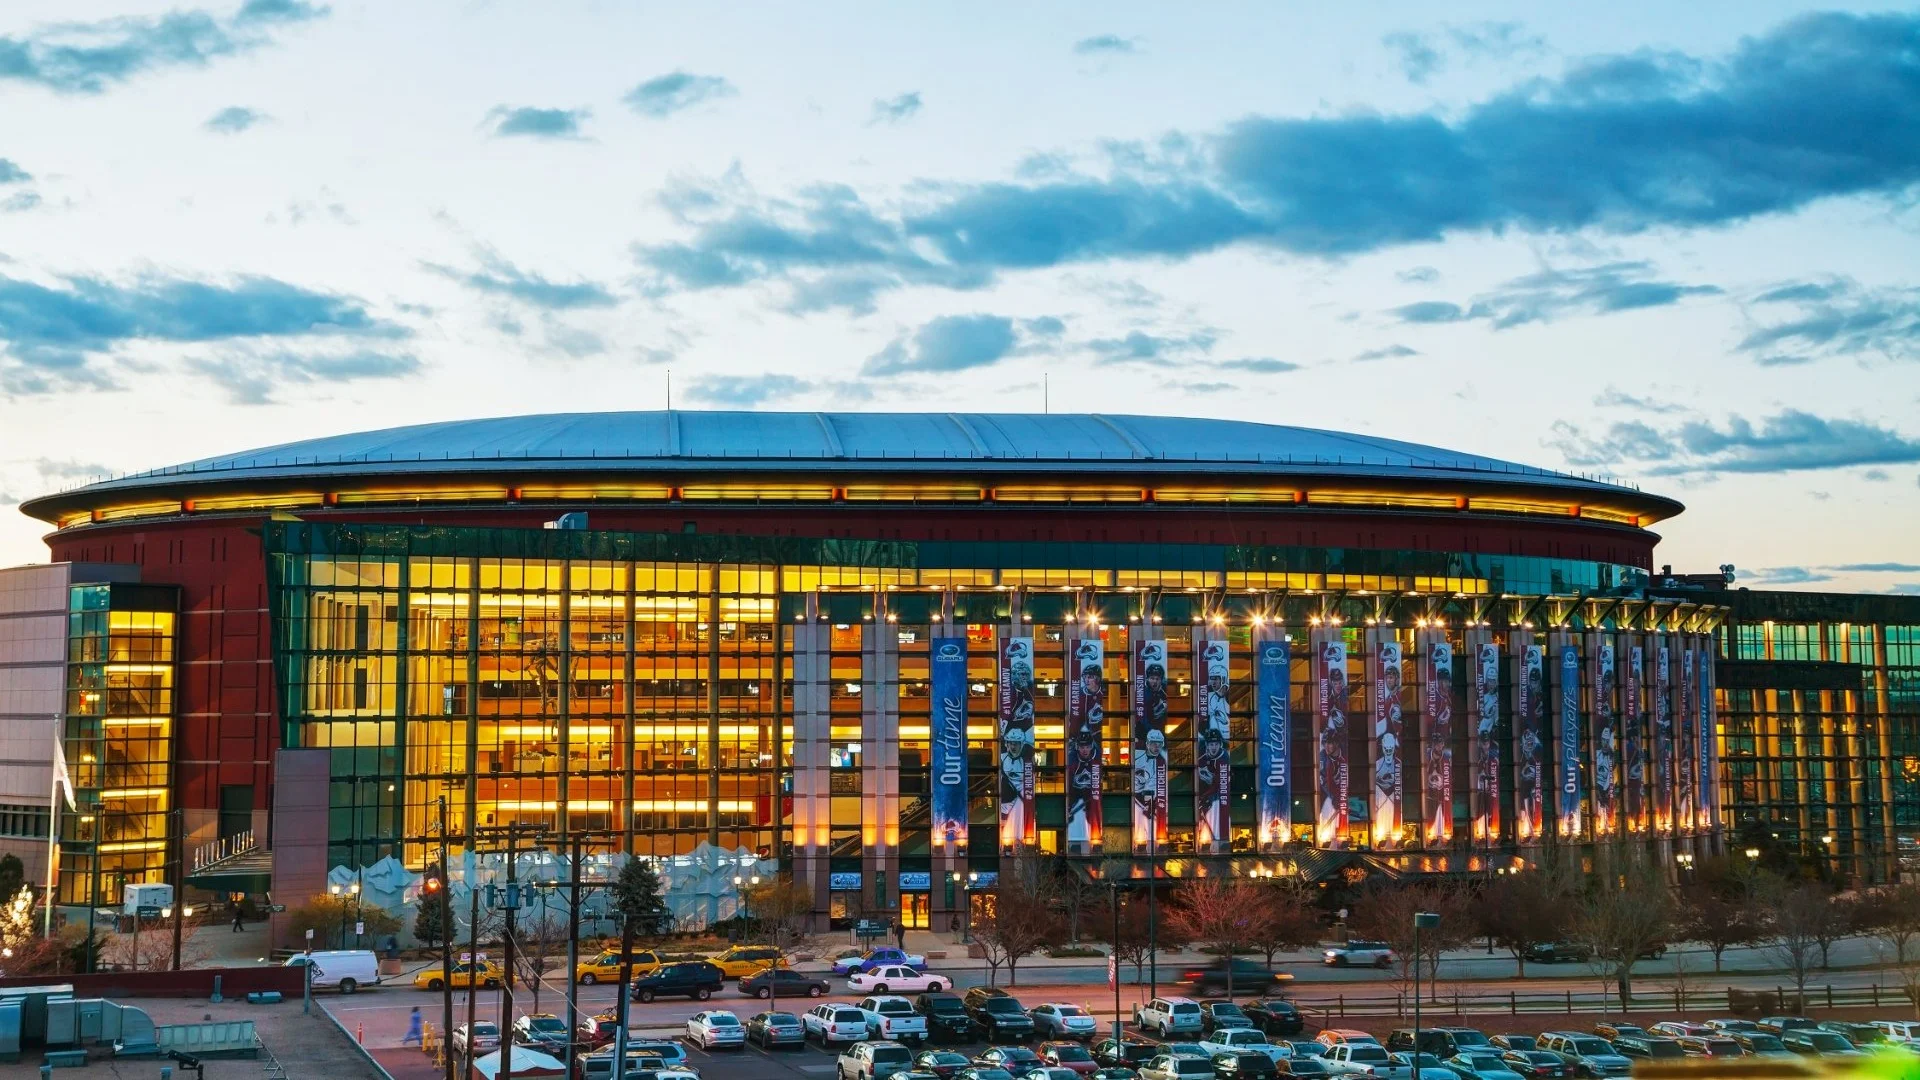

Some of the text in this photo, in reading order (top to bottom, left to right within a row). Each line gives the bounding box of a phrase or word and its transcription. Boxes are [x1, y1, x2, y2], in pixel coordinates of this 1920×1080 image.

[1002, 667, 1011, 715] #1 VARLAMOV
[1072, 680, 1080, 716] #4 BARRIE
[1200, 684, 1208, 717] #8 HEJDA
[1428, 680, 1436, 702] CLICHE
[1137, 706, 1144, 717] #6
[1321, 704, 1329, 717] #11
[936, 696, 962, 785] Our time
[1263, 695, 1286, 786] Our team
[1562, 686, 1577, 794] Our playoffs
[1024, 762, 1033, 800] #2 HOLDEN
[1092, 764, 1100, 800] #5 GUENIN
[1157, 764, 1166, 808] #7 MITCHELL
[1219, 764, 1228, 805] #9 DUCHENE
